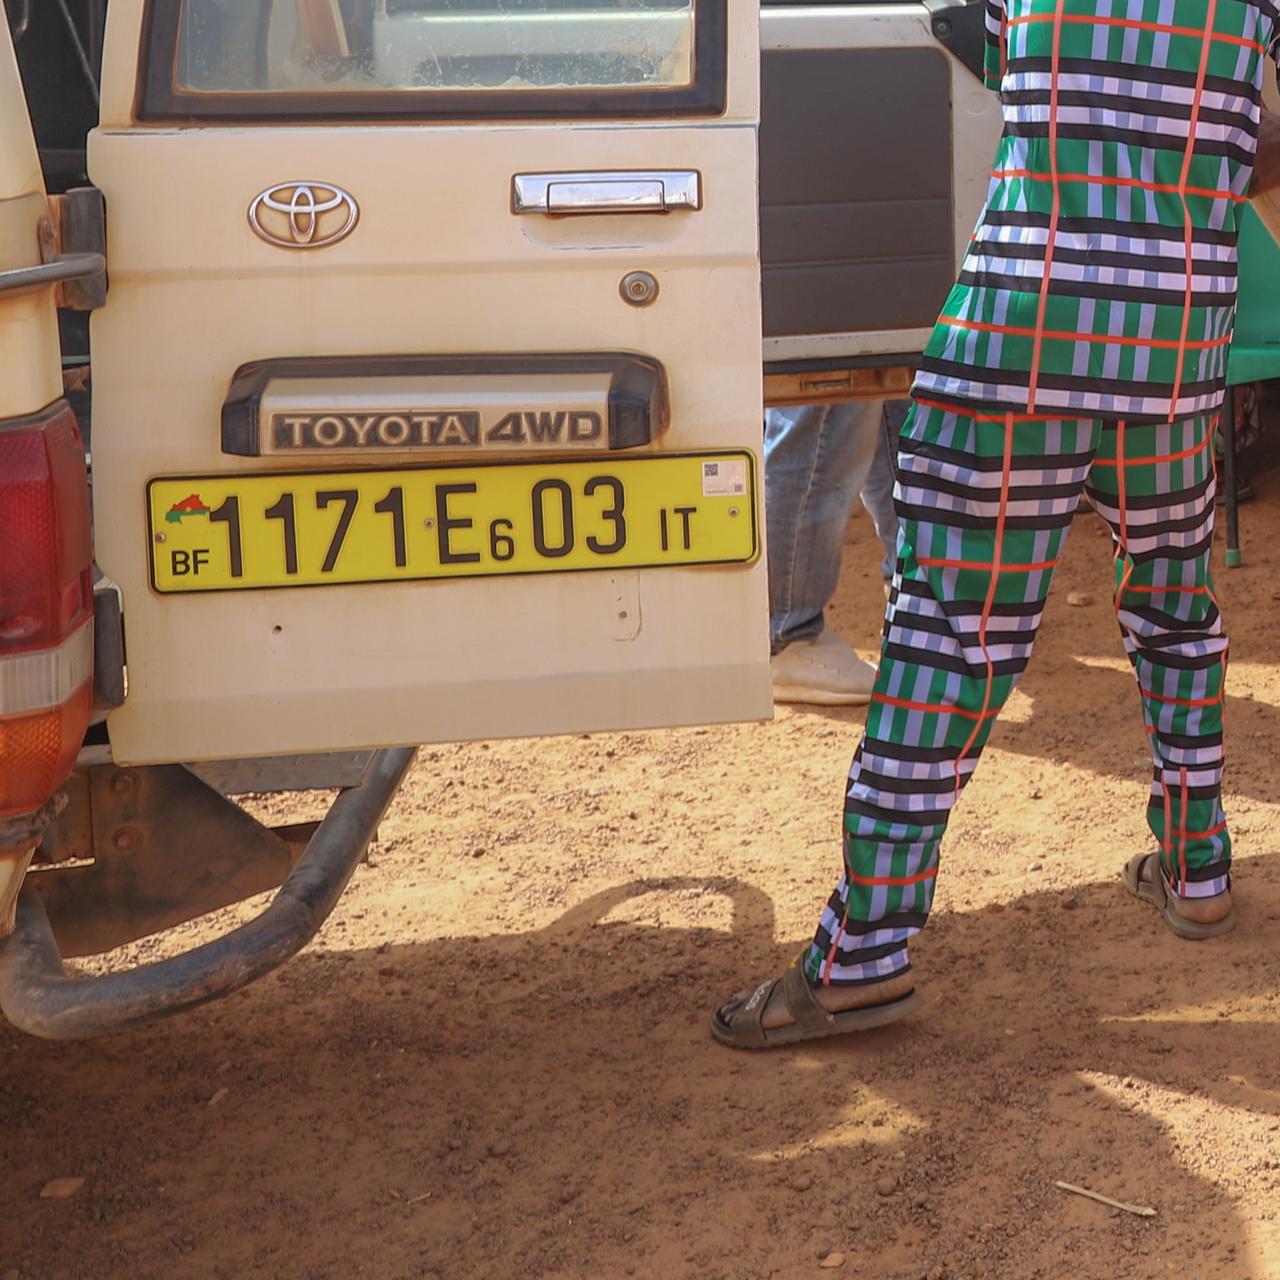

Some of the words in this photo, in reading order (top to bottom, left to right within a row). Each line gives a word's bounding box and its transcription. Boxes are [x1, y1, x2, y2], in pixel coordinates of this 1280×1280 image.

[283, 416, 472, 447] TOYOTA
[485, 410, 602, 443] 4WD
[660, 506, 698, 552] IT
[170, 548, 210, 576] BF
